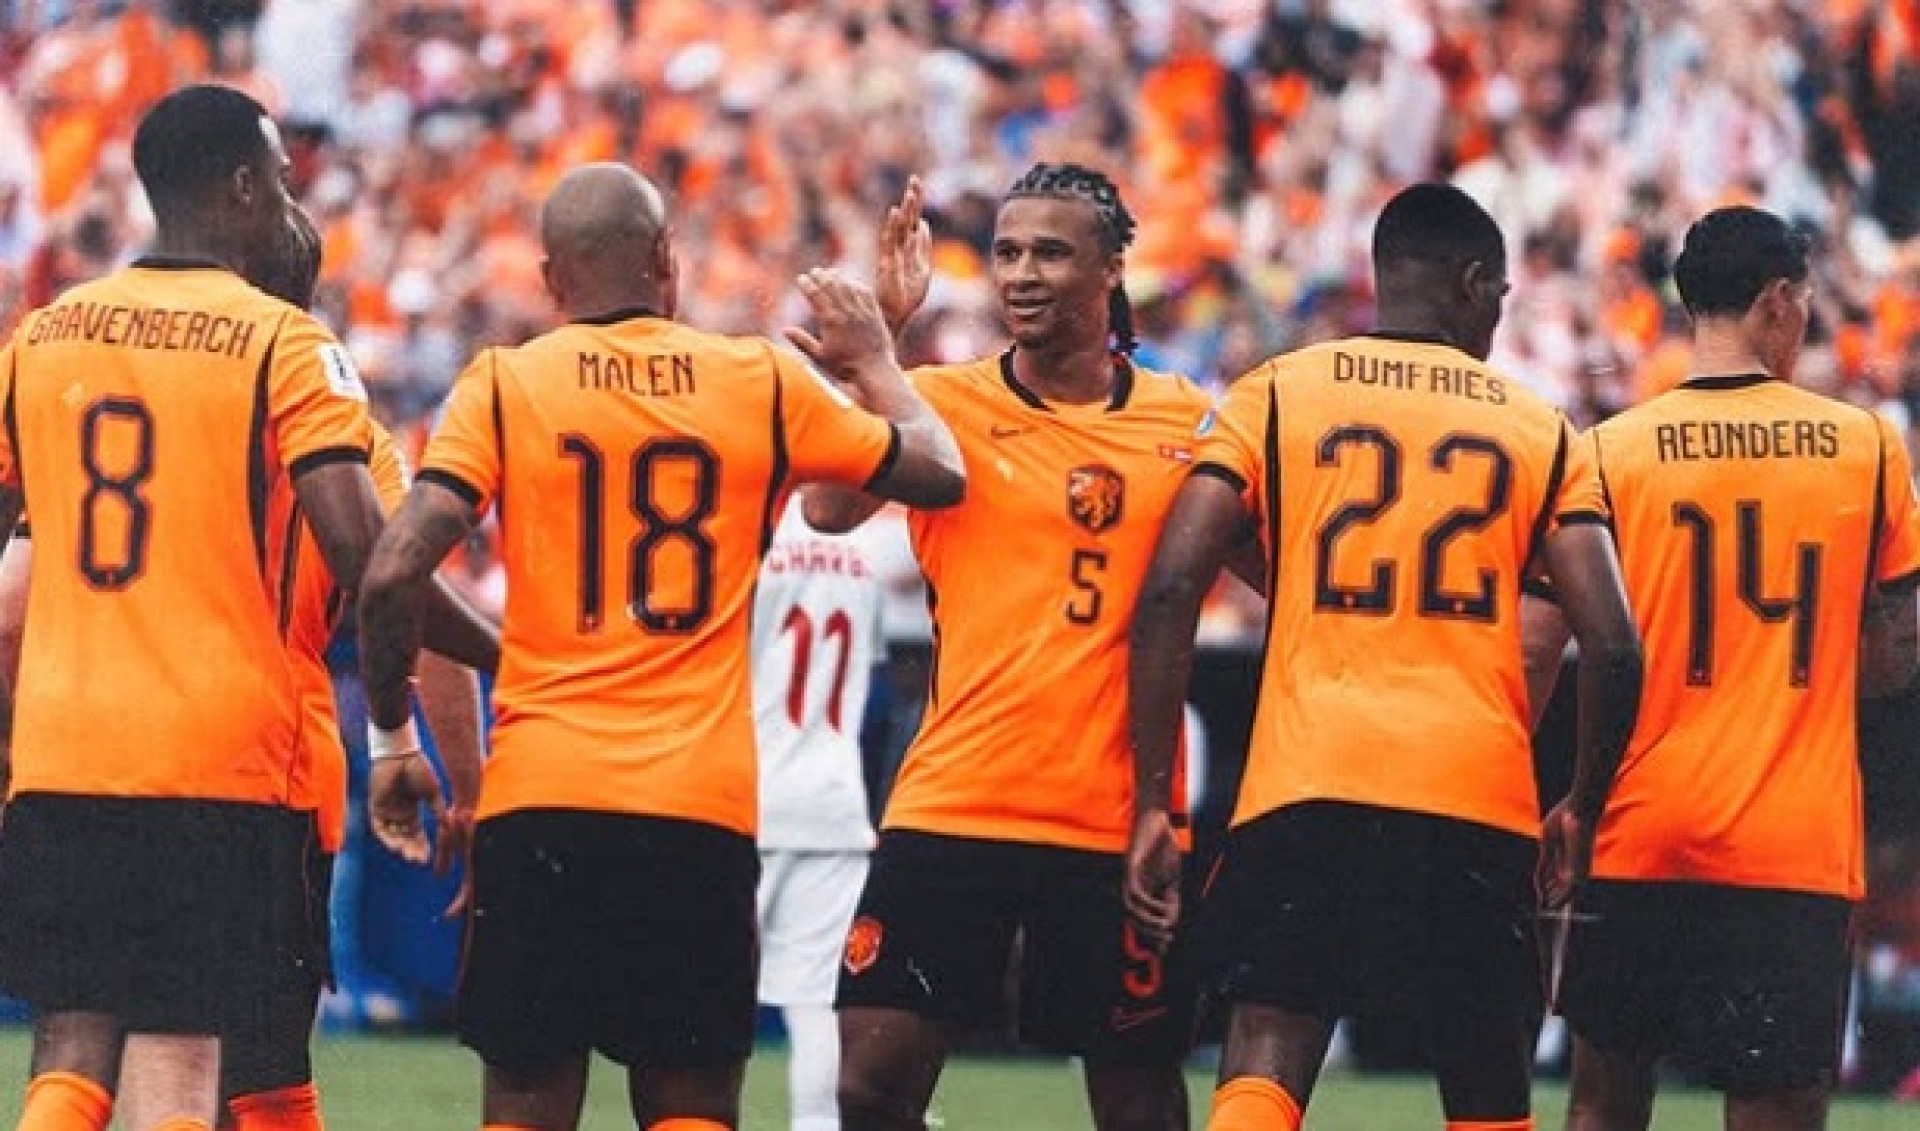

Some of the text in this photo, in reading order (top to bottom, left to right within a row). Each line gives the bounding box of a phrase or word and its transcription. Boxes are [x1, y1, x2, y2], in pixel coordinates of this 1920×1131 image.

[27, 301, 257, 359] GRAVENBERCH
[579, 352, 696, 396] MALEN
[1334, 351, 1507, 405] DUMFRIES
[80, 395, 154, 592] 8
[558, 432, 723, 636] 18
[1312, 423, 1514, 626] 22
[1067, 549, 1107, 626] 5
[1671, 498, 1824, 689] 14
[778, 603, 853, 734] 11
[1121, 918, 1165, 1000] 5
